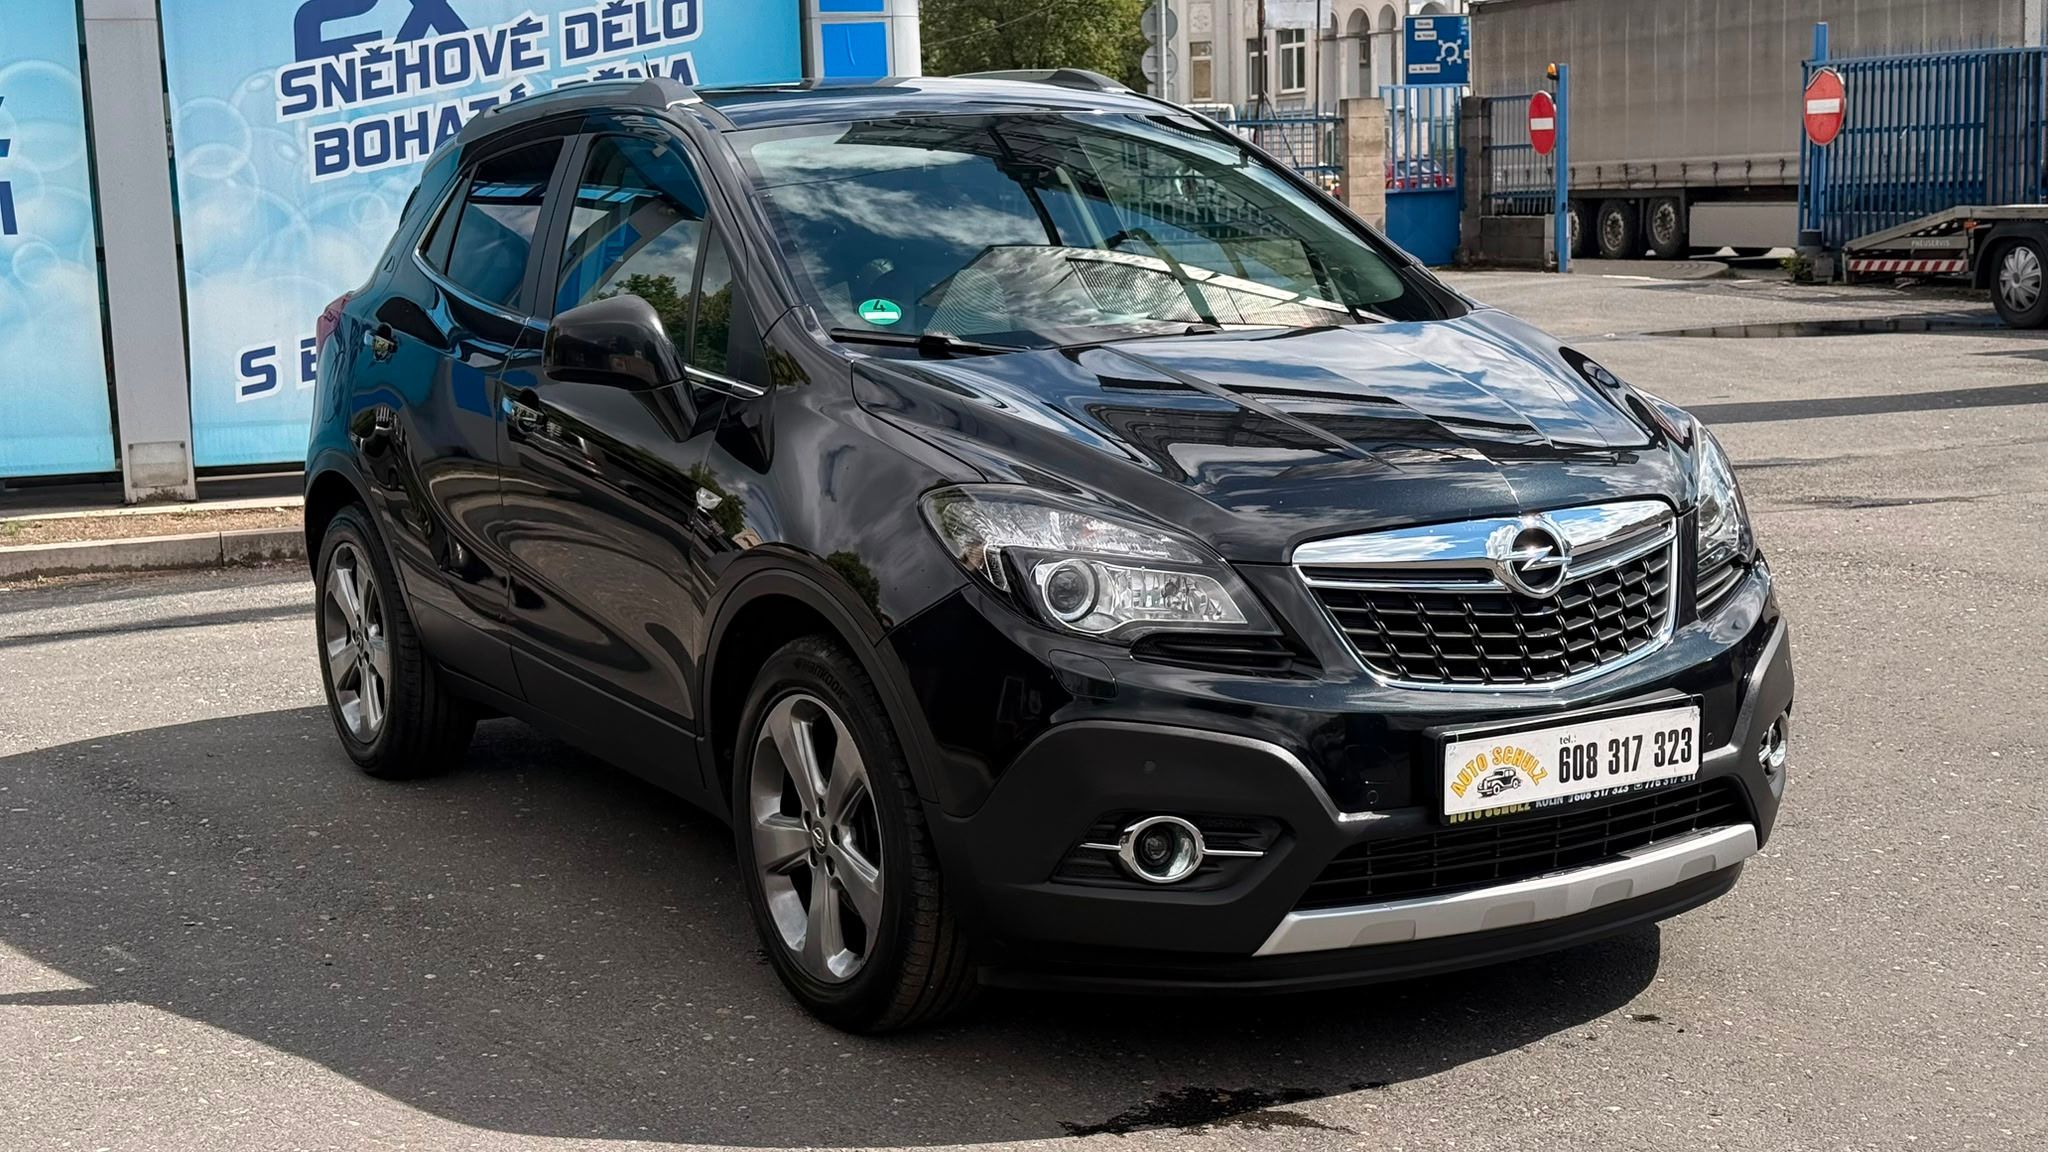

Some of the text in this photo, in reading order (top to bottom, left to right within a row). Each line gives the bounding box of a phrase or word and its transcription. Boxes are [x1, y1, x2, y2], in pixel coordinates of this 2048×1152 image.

[280, 0, 698, 117] SNĚHOVÉ DĚLO
[1911, 239, 1950, 248] PNEUSERVIS
[873, 299, 886, 312] 4
[240, 345, 277, 396] S
[1450, 745, 1549, 798] AUTO SCHULZ
[1558, 727, 1693, 784] 608 317 323
